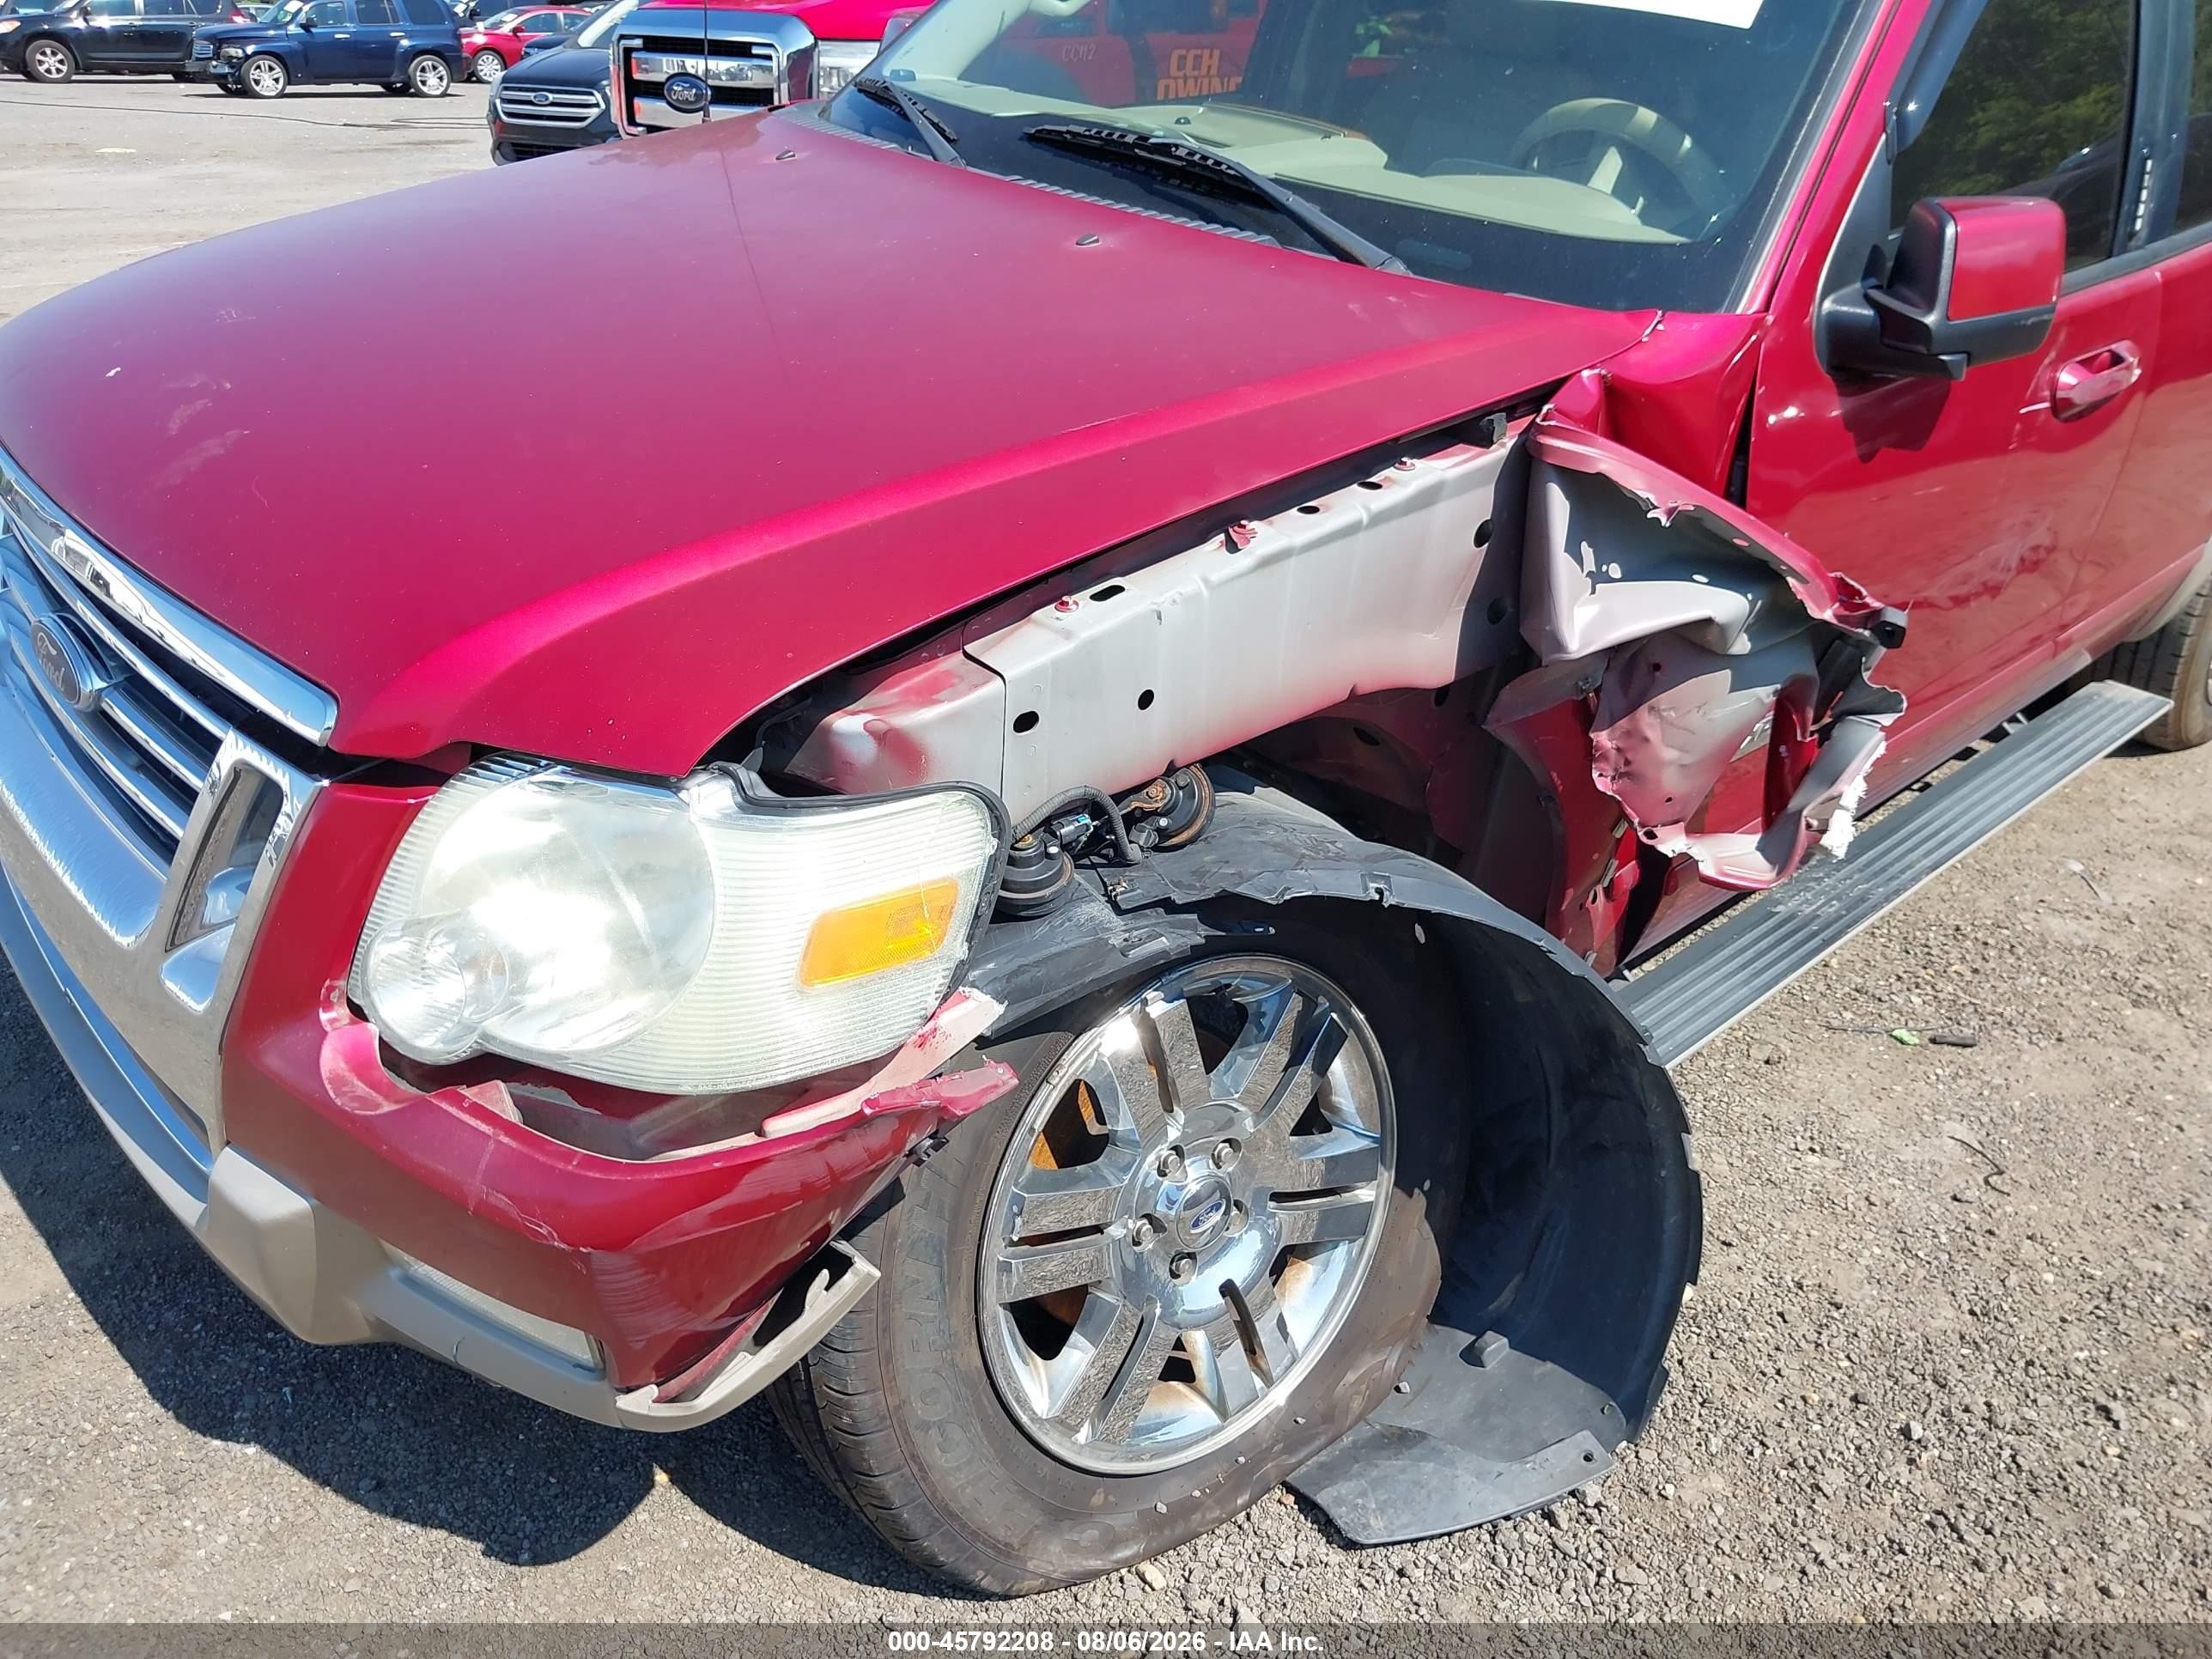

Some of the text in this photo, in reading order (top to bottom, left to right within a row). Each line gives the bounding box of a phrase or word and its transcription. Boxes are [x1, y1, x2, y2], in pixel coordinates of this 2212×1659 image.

[1170, 49, 1221, 77] CCH
[672, 82, 696, 101] Ford
[37, 632, 66, 691] Ford
